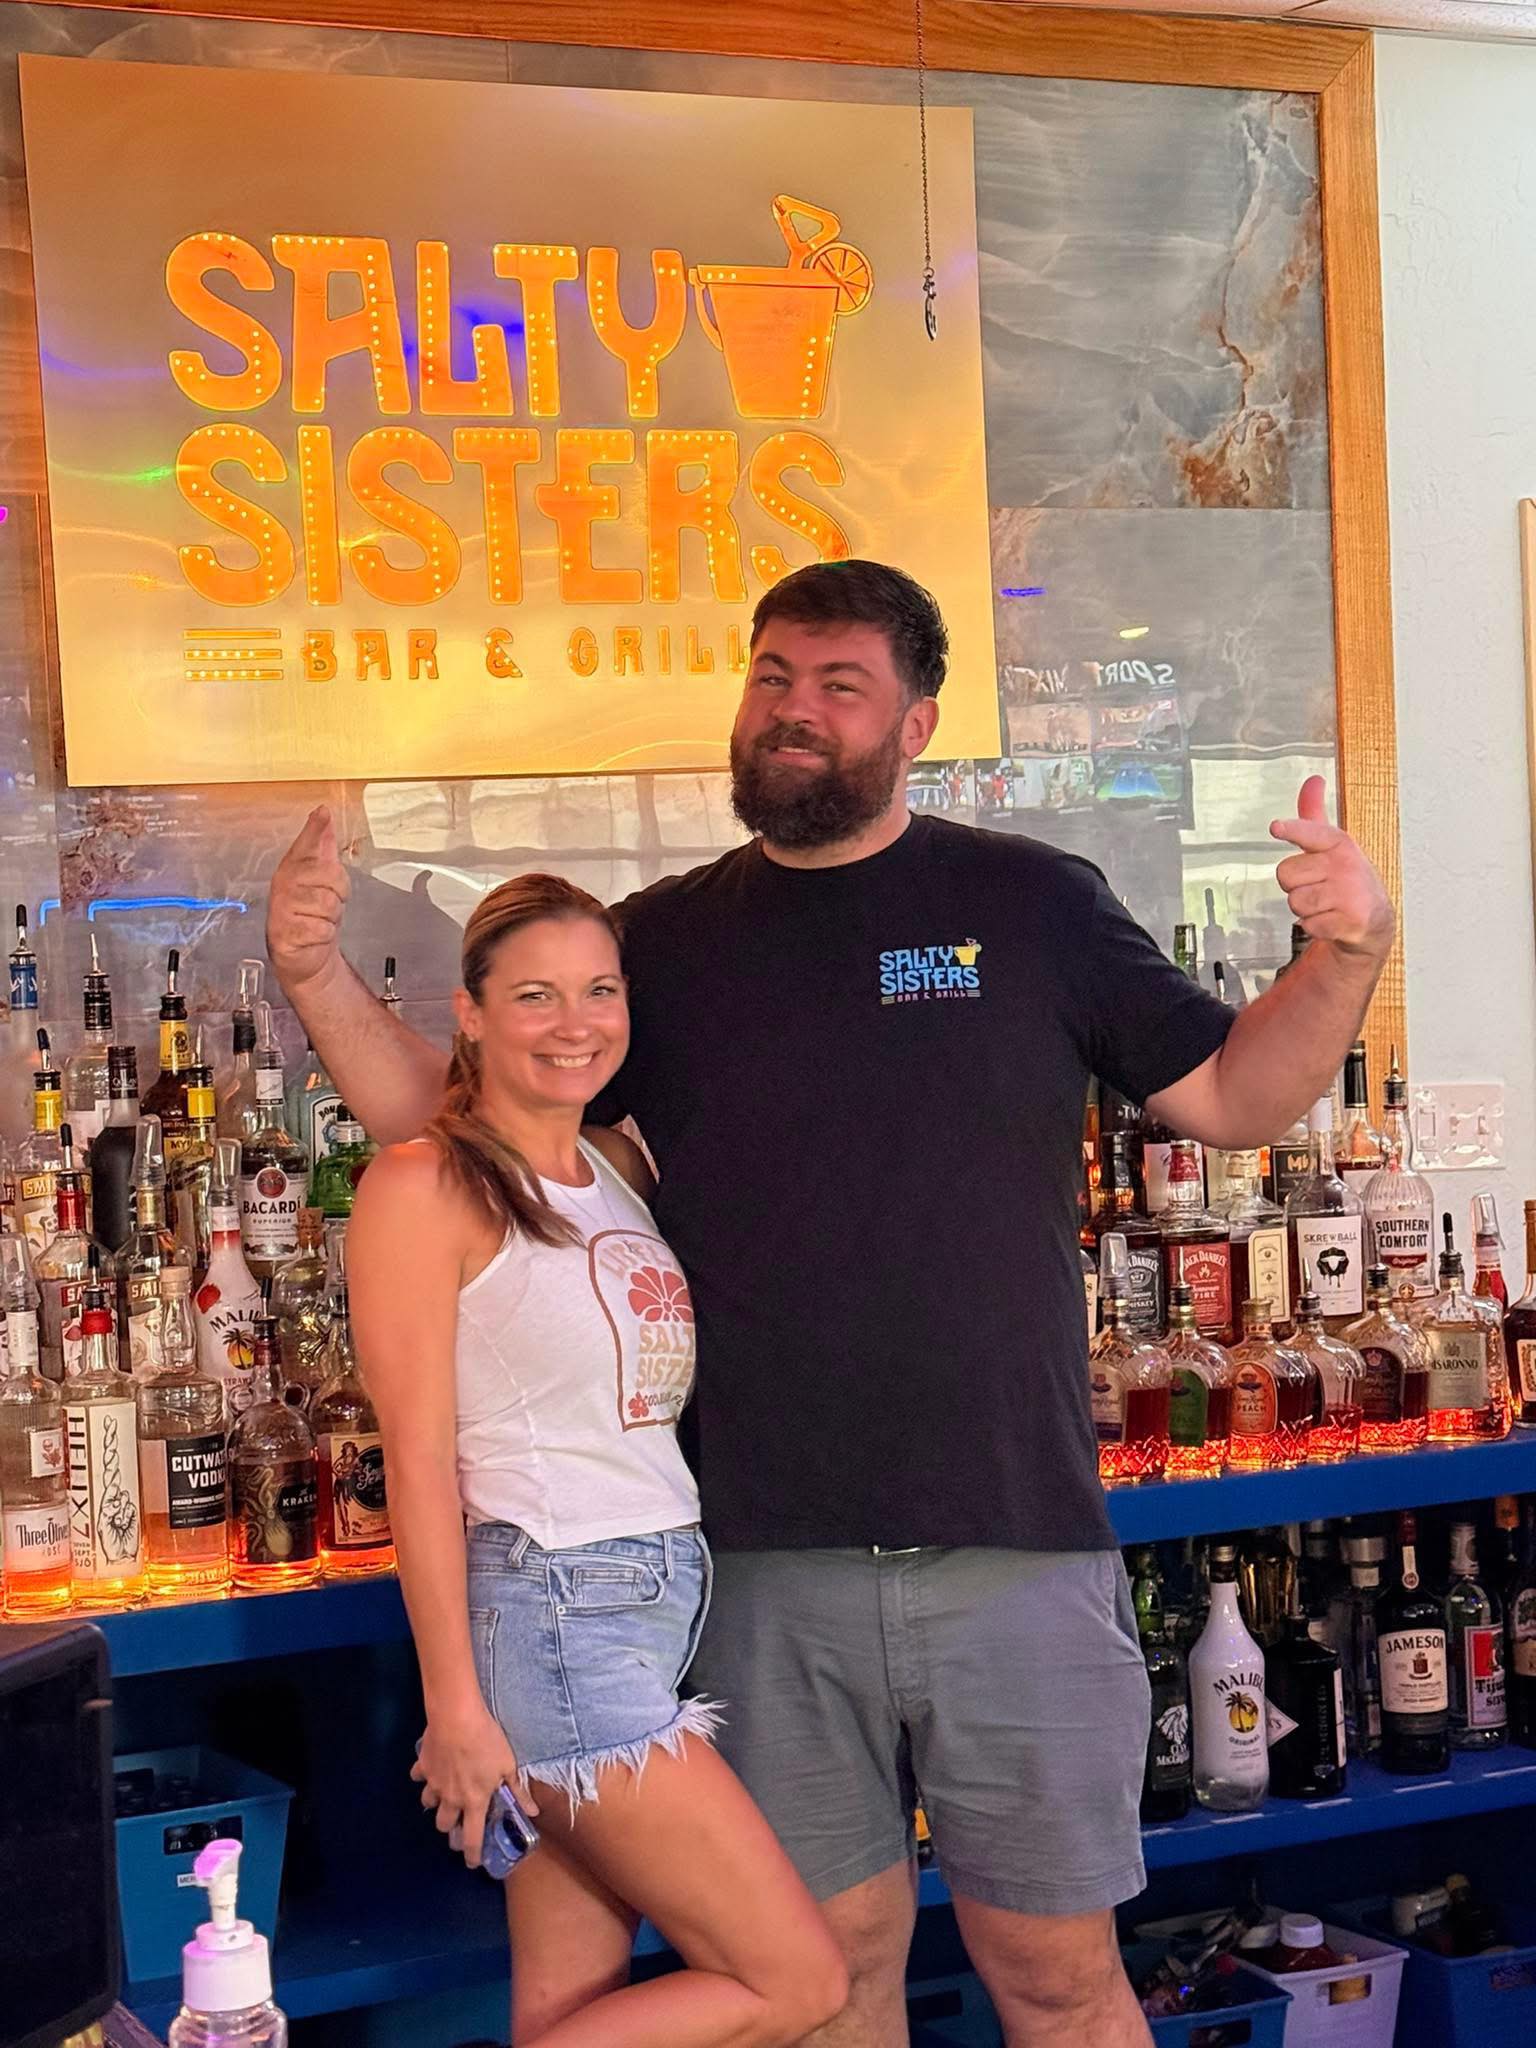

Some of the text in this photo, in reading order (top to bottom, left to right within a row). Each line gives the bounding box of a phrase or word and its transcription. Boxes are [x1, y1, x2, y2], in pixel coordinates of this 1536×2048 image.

[164, 230, 687, 418] SALTY
[173, 421, 854, 608] SISTERS
[301, 623, 749, 682] BAR & GRILL
[879, 945, 954, 972] SALTY
[880, 966, 980, 995] SISTERS
[936, 990, 966, 999] GRILL
[1375, 1218, 1430, 1234] SOUTHERN
[1379, 1234, 1428, 1248] COMFORT
[1193, 1291, 1217, 1299] FIRE
[639, 1324, 694, 1355] SALT
[1431, 1360, 1479, 1370] ISARONNO
[15, 1523, 48, 1548] Three
